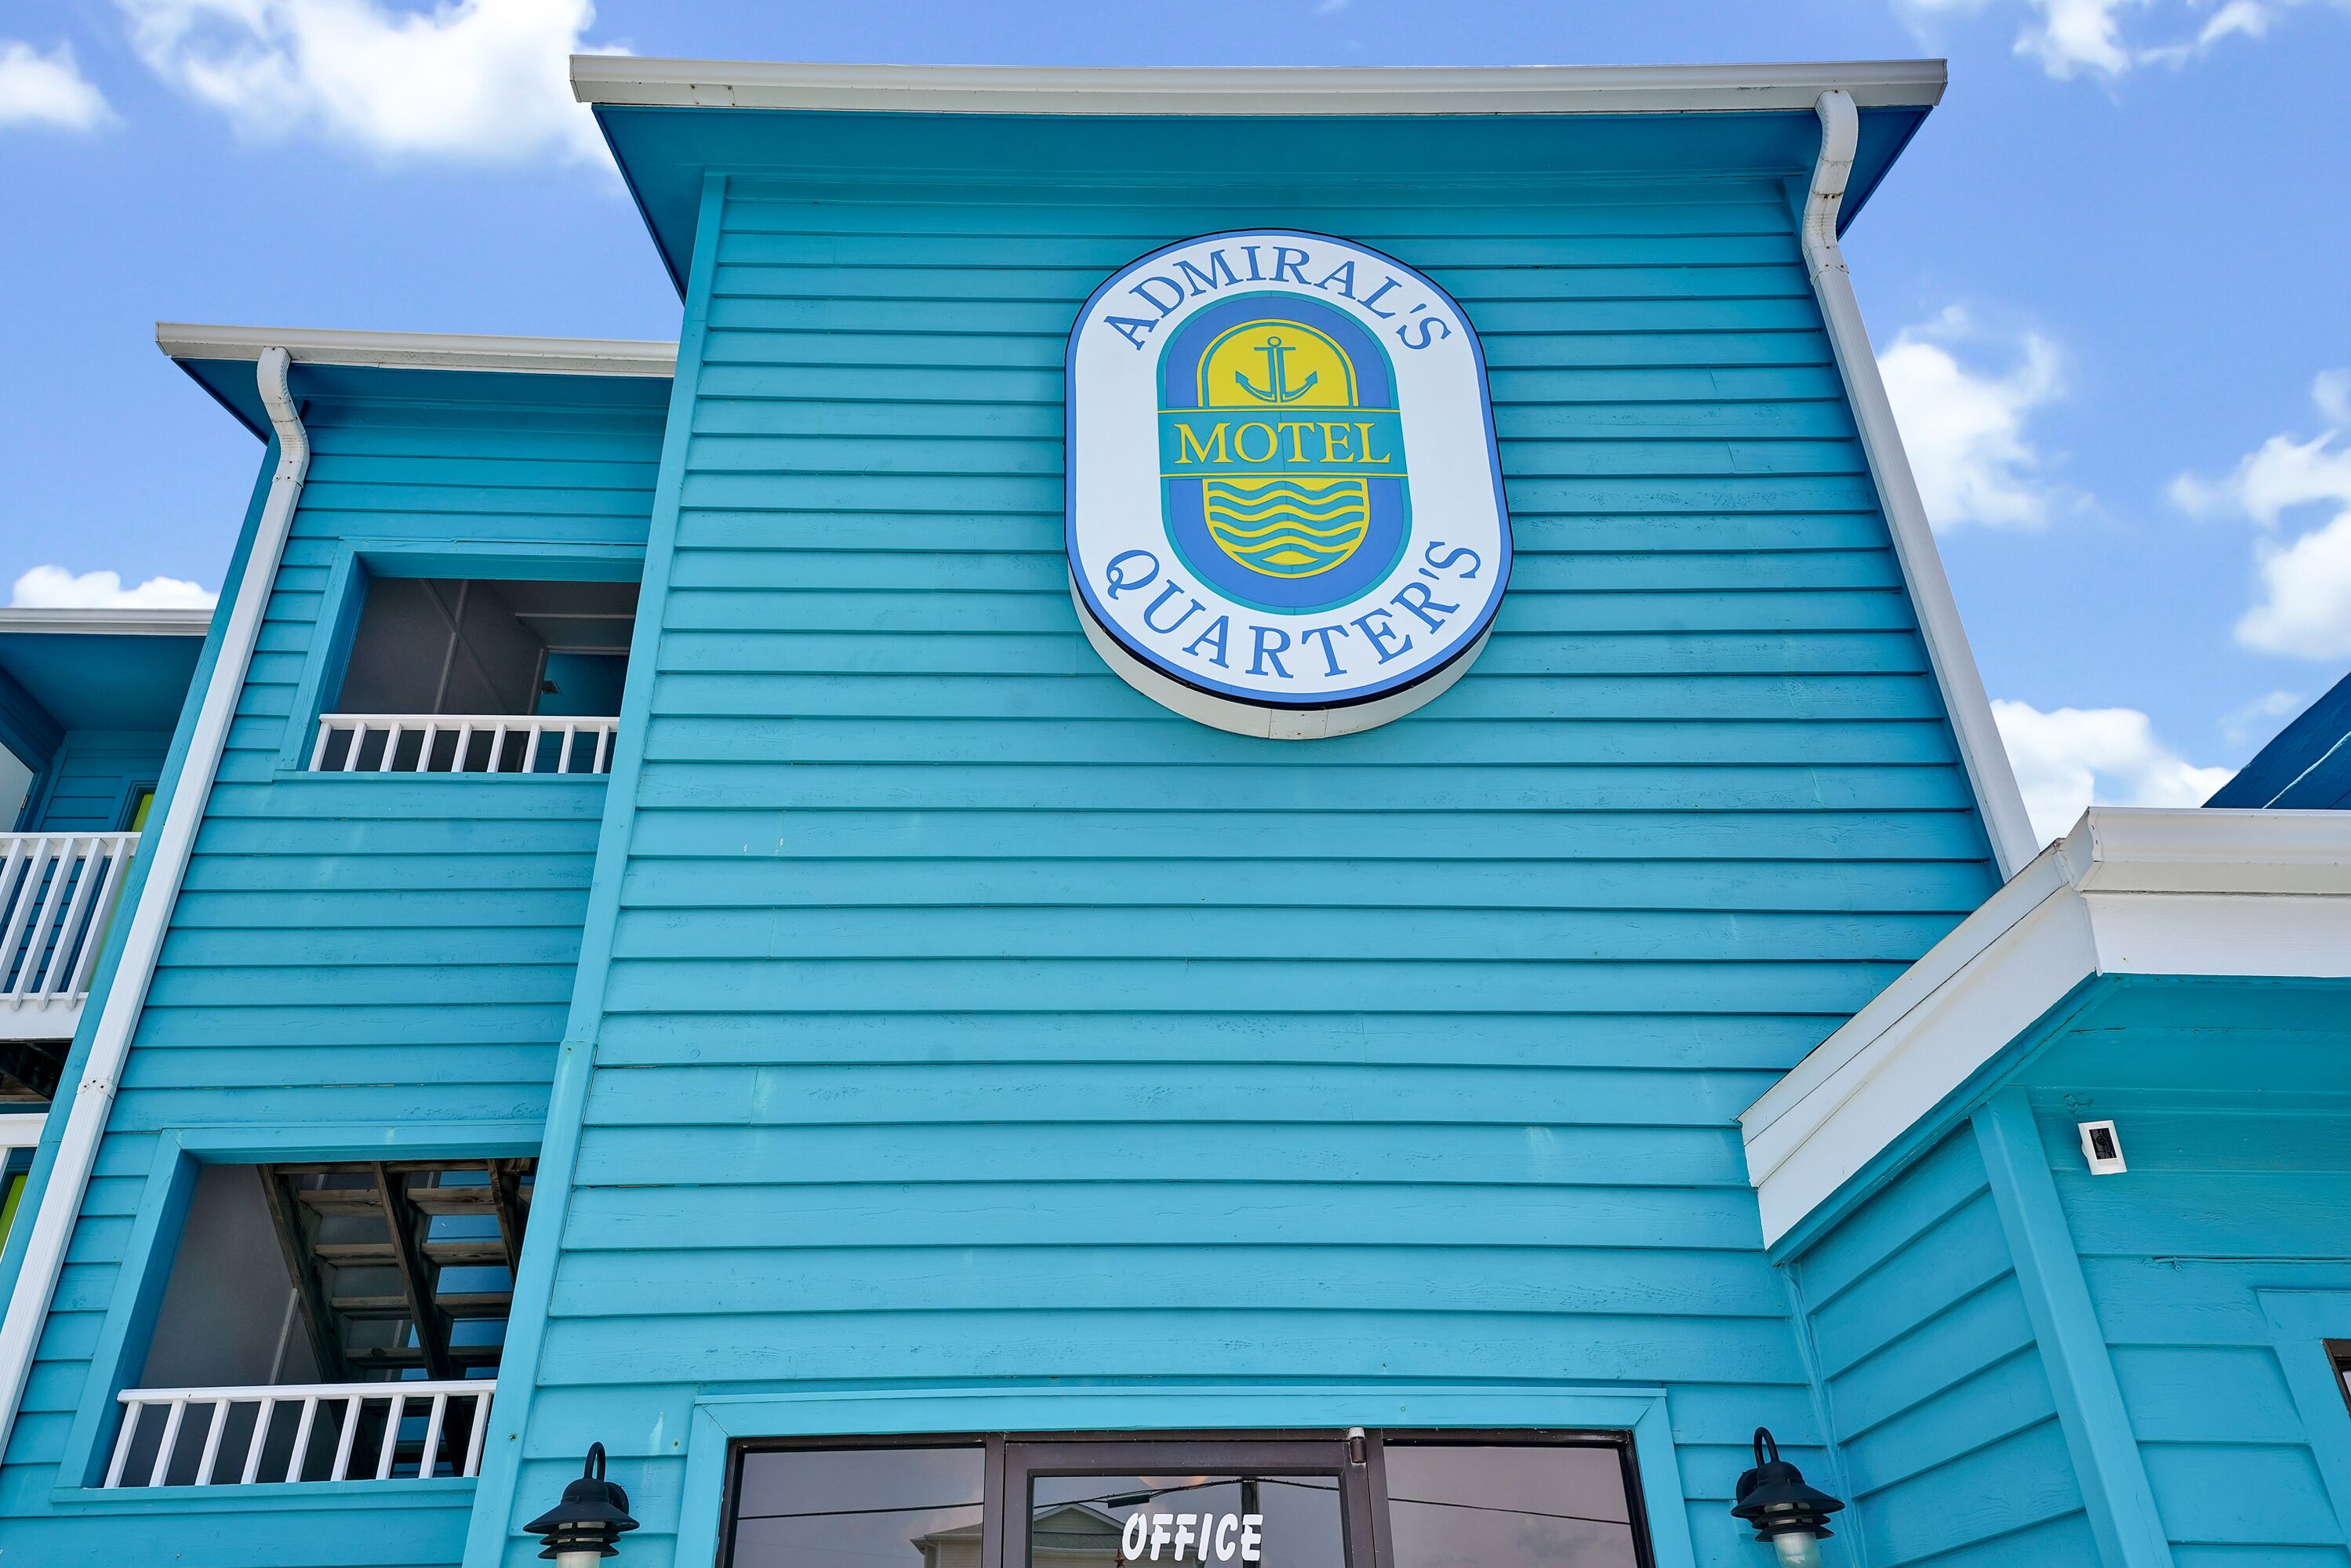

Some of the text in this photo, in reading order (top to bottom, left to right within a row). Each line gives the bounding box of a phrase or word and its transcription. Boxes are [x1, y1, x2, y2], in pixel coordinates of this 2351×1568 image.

[1103, 245, 1452, 351] ADMIRAL'S
[1174, 422, 1391, 464] MOTEL
[1106, 541, 1481, 679] QUARTER'S
[1121, 1512, 1263, 1561] OFFICE
